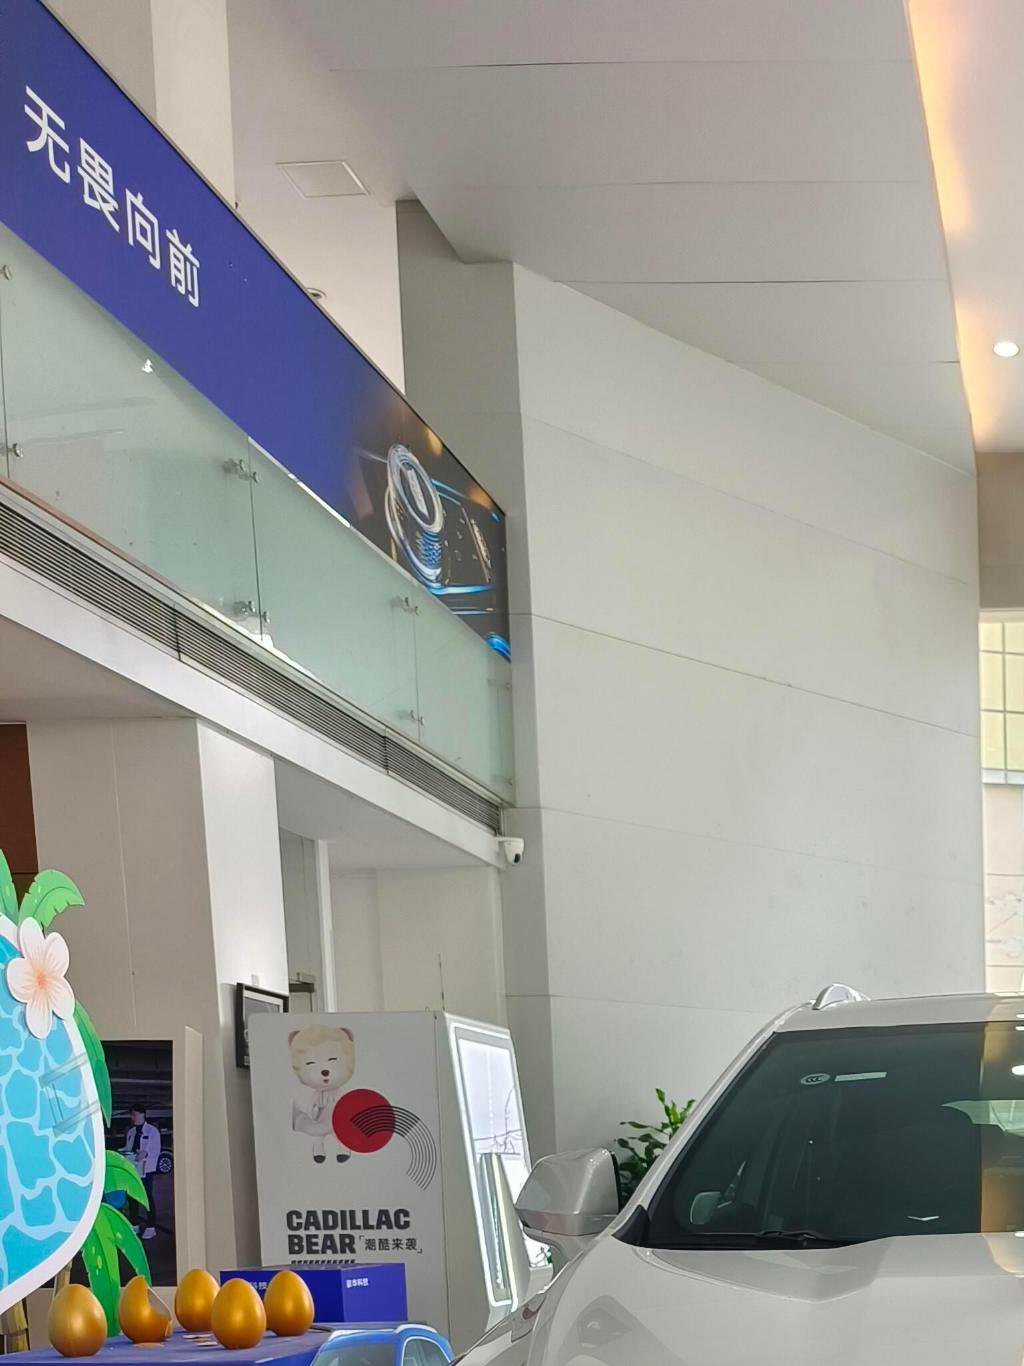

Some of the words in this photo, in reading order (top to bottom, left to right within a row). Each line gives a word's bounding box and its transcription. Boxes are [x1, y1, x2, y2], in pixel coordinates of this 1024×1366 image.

[24, 85, 200, 308] 无畏向前
[286, 1208, 411, 1231] CADILLAC
[288, 1233, 356, 1254] BEAR
